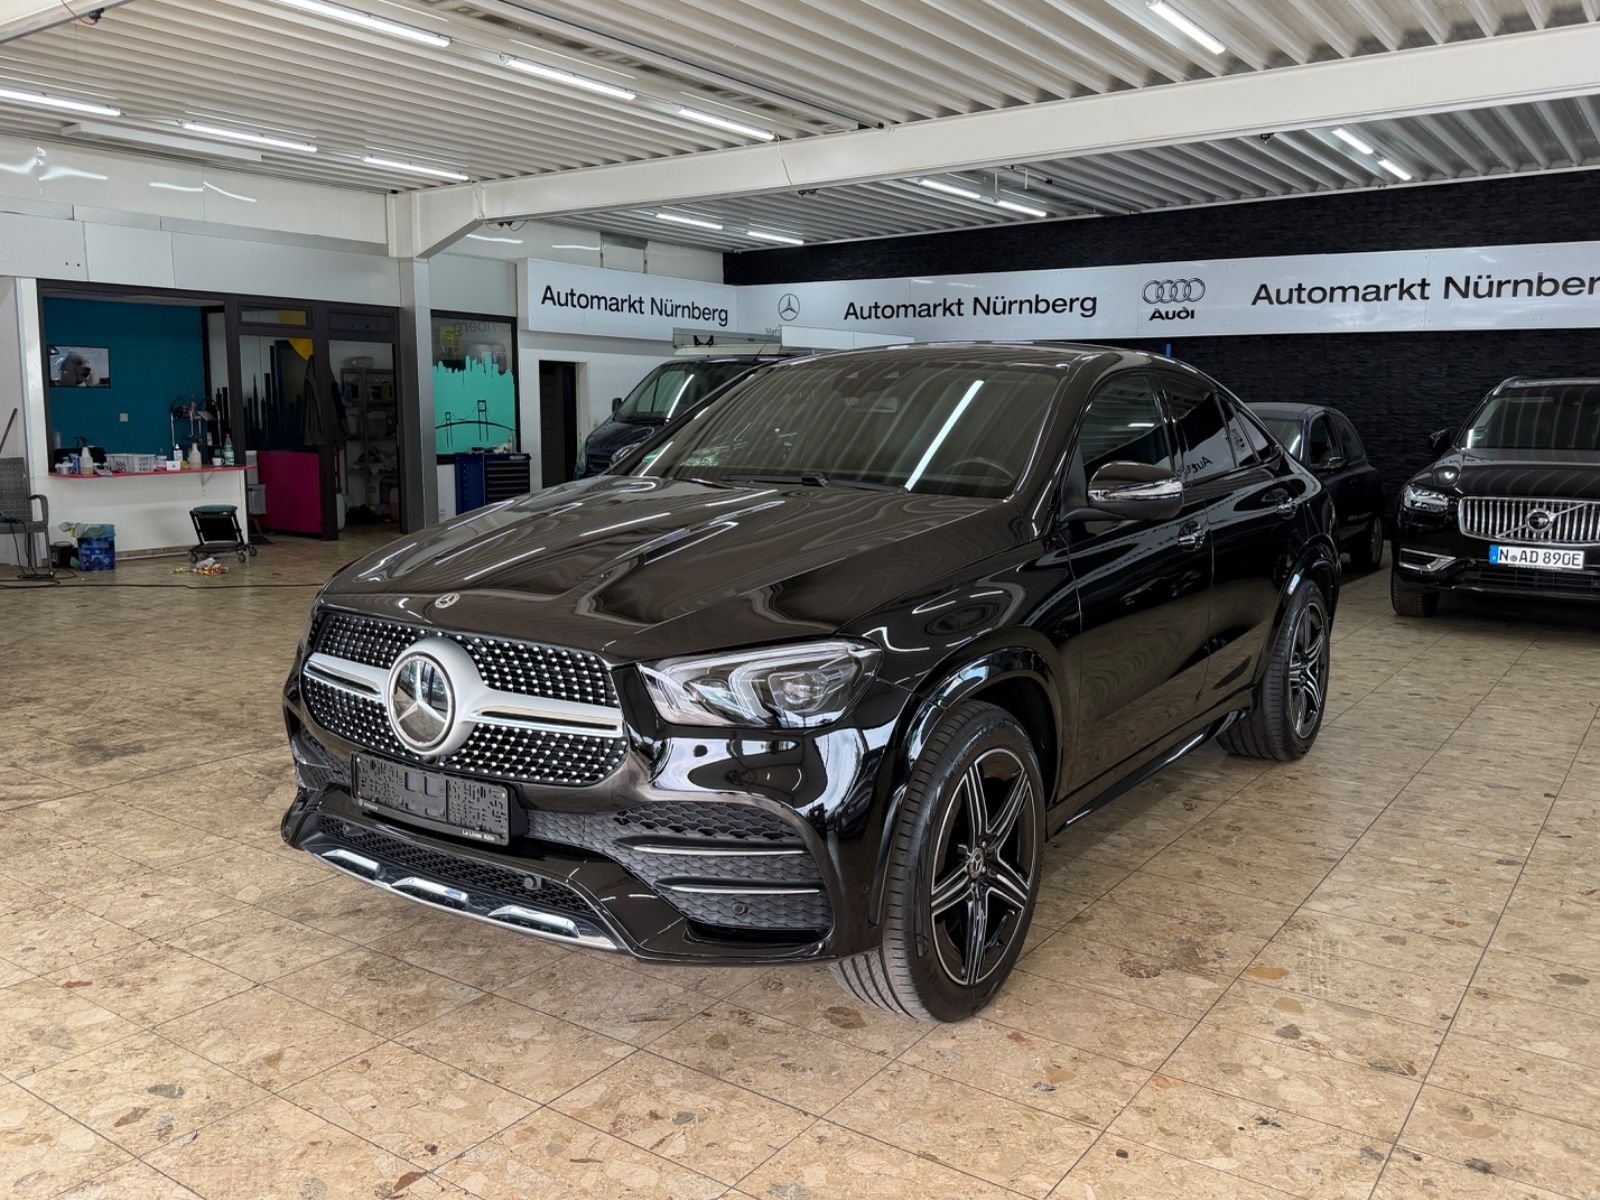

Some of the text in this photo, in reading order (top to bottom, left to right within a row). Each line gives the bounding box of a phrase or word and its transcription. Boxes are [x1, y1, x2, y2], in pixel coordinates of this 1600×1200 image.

[1251, 277, 1431, 306] Automarkt
[540, 285, 728, 327] Automarkt Nürnberg
[843, 294, 1098, 321] Automarkt Nürnberg
[1499, 549, 1582, 567] N AD 890E
